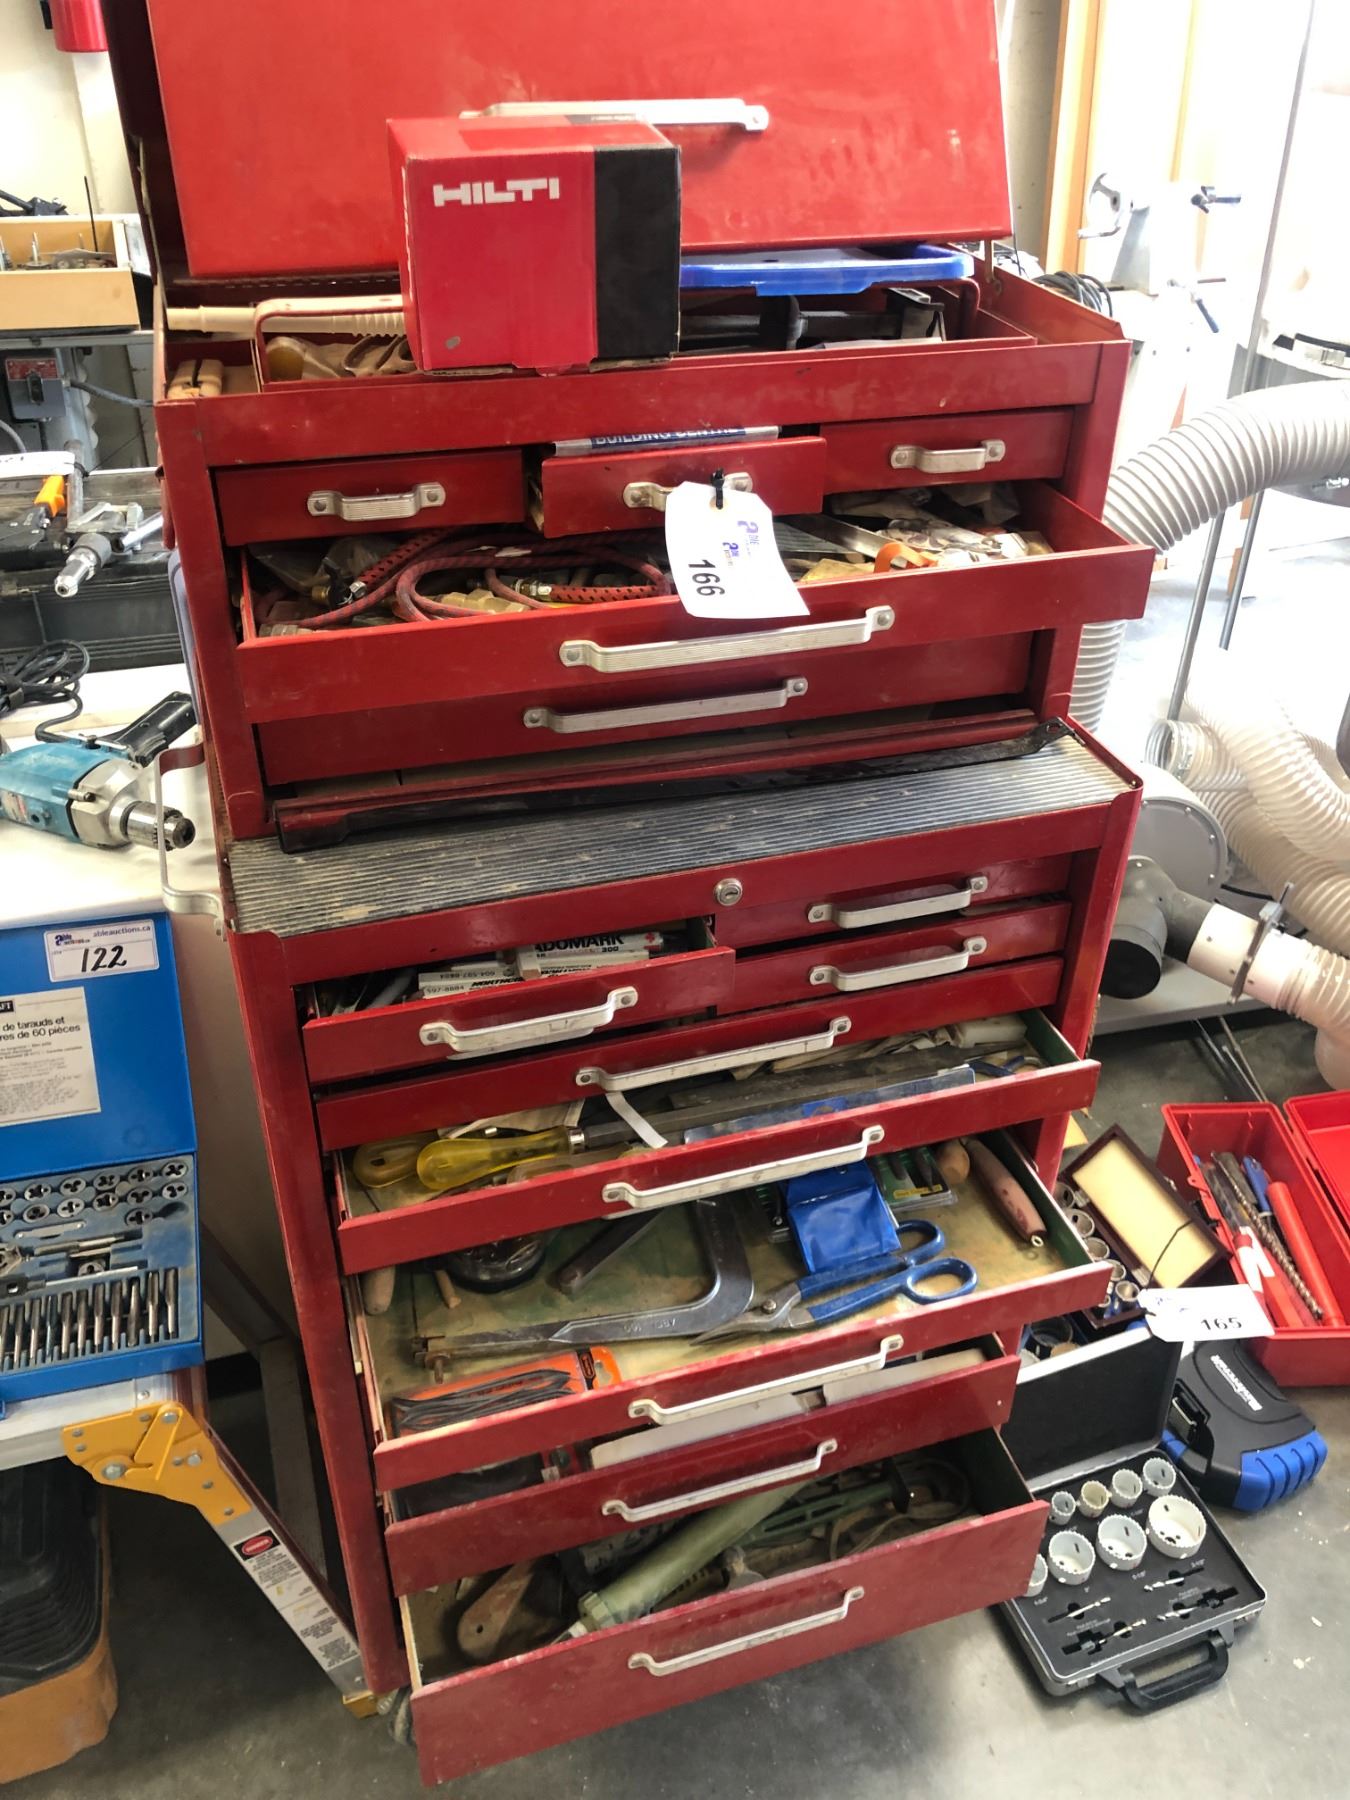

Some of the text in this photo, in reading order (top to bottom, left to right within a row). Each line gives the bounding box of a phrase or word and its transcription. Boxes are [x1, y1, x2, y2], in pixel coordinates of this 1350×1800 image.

[433, 177, 559, 207] HILTI
[688, 559, 725, 596] 166
[93, 925, 151, 938] ableauctions.ca
[81, 945, 127, 972] 122
[3, 1016, 65, 1032] de tarauds et
[17, 1030, 29, 1039] de
[32, 1028, 46, 1036] 60
[1200, 1317, 1242, 1330] 165
